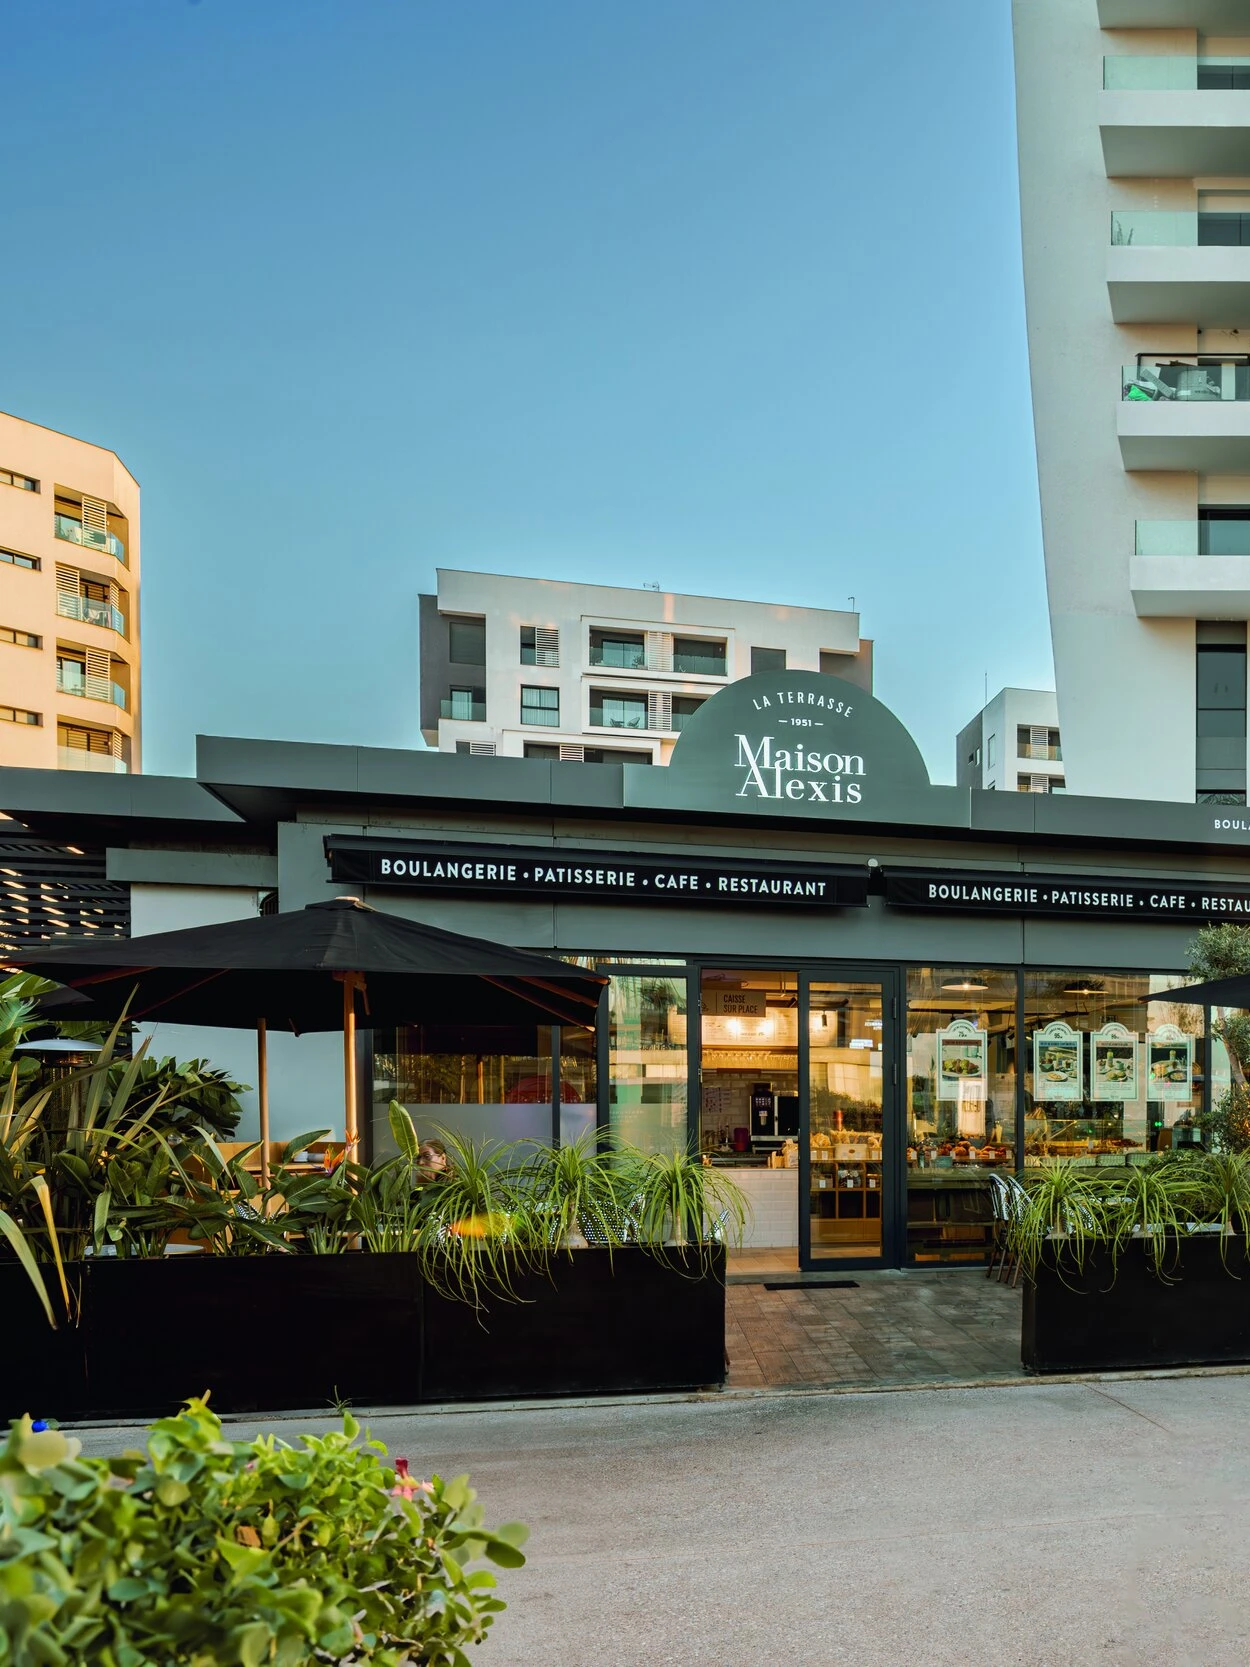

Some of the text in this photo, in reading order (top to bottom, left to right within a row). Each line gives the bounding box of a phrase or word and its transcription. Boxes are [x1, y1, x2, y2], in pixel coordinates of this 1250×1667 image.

[752, 691, 854, 718] LA TERRASSE
[790, 717, 813, 727] 1951
[733, 733, 868, 776] Maison
[735, 766, 863, 805] Alexis
[380, 857, 827, 896] BOULANGERIE PATISSERIE CAFE RESTAURANT
[927, 883, 1039, 903] BOULANGERIE
[1050, 890, 1135, 907] PATISSERIE
[1149, 894, 1187, 909] CAFE
[722, 1004, 758, 1015] SUR PLACE
[723, 994, 746, 1003] CAISSE
